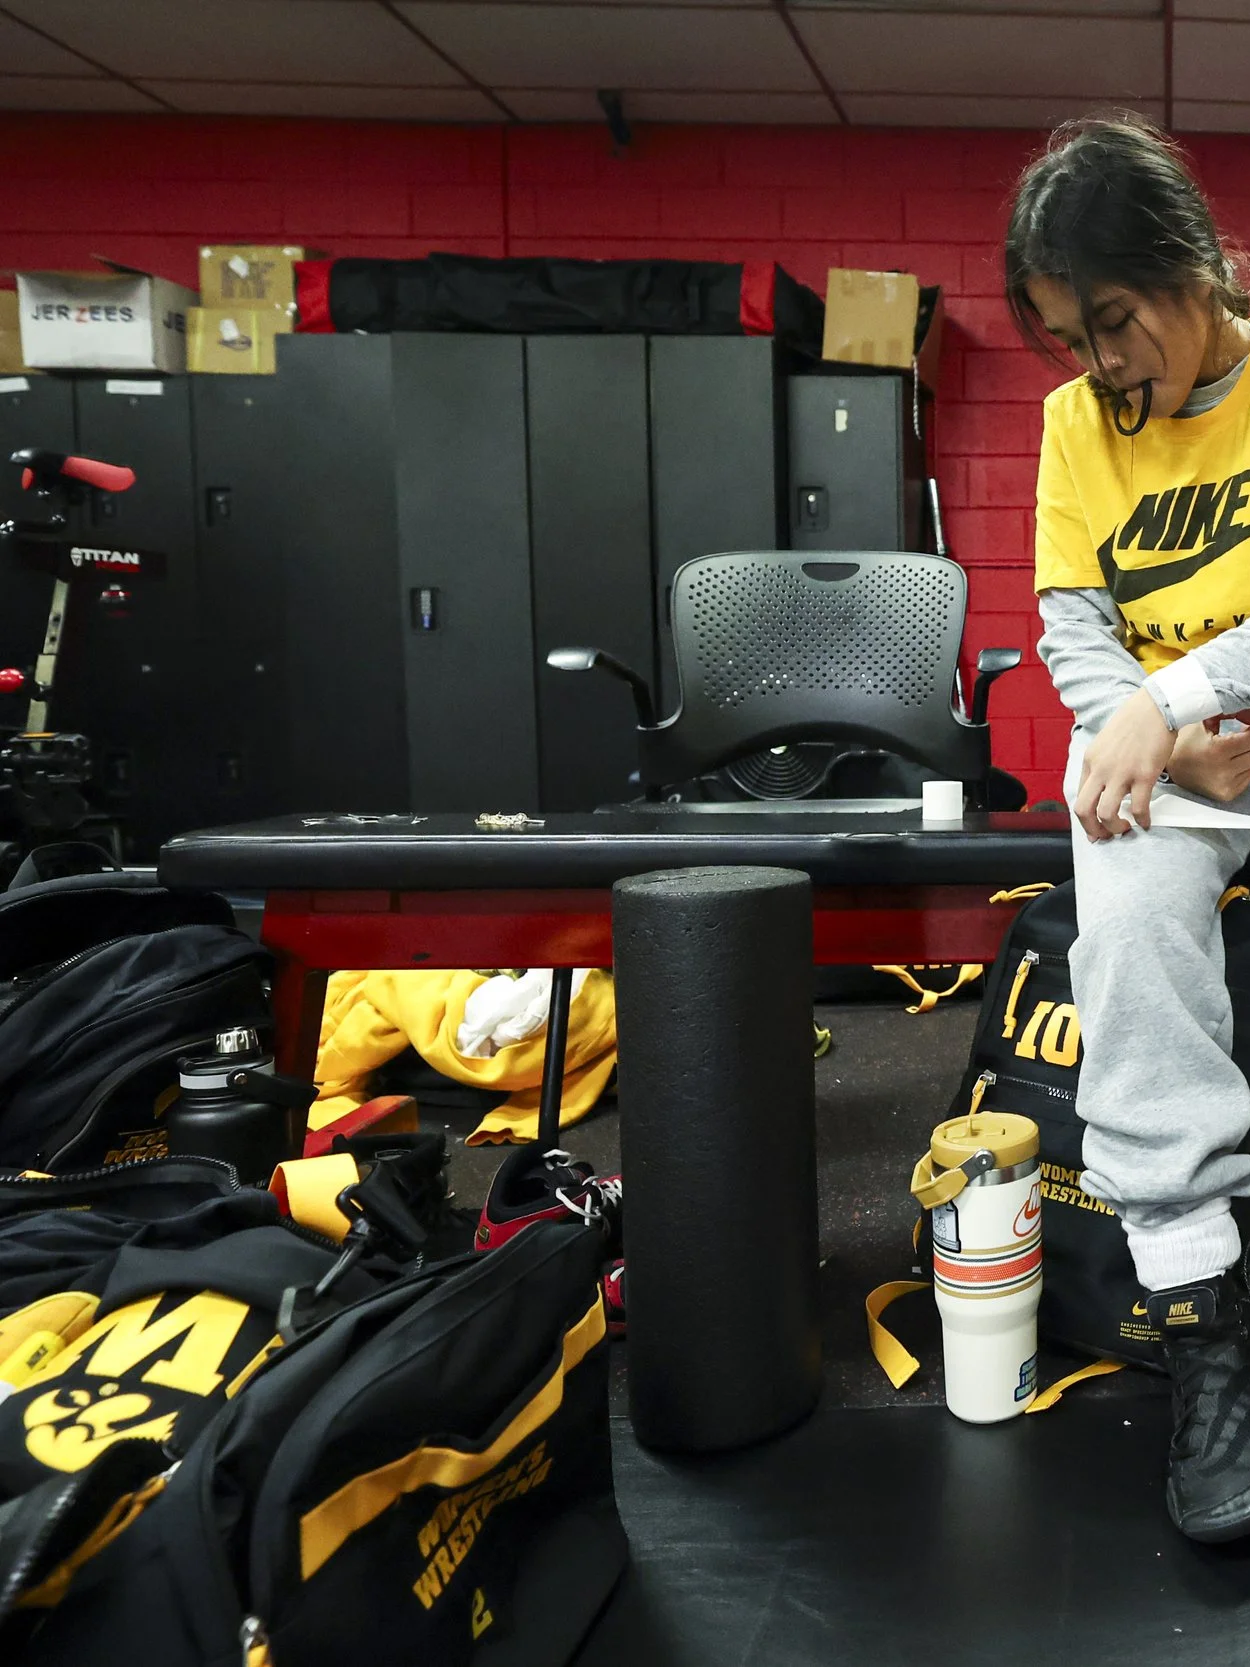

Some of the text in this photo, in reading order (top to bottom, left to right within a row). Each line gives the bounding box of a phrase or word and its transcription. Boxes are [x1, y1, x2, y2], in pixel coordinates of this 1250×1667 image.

[31, 304, 134, 323] JERZEES
[81, 549, 140, 565] TITAN
[1014, 1001, 1082, 1067] IO
[1168, 1301, 1194, 1317] NIKE
[472, 1586, 494, 1640] 2
